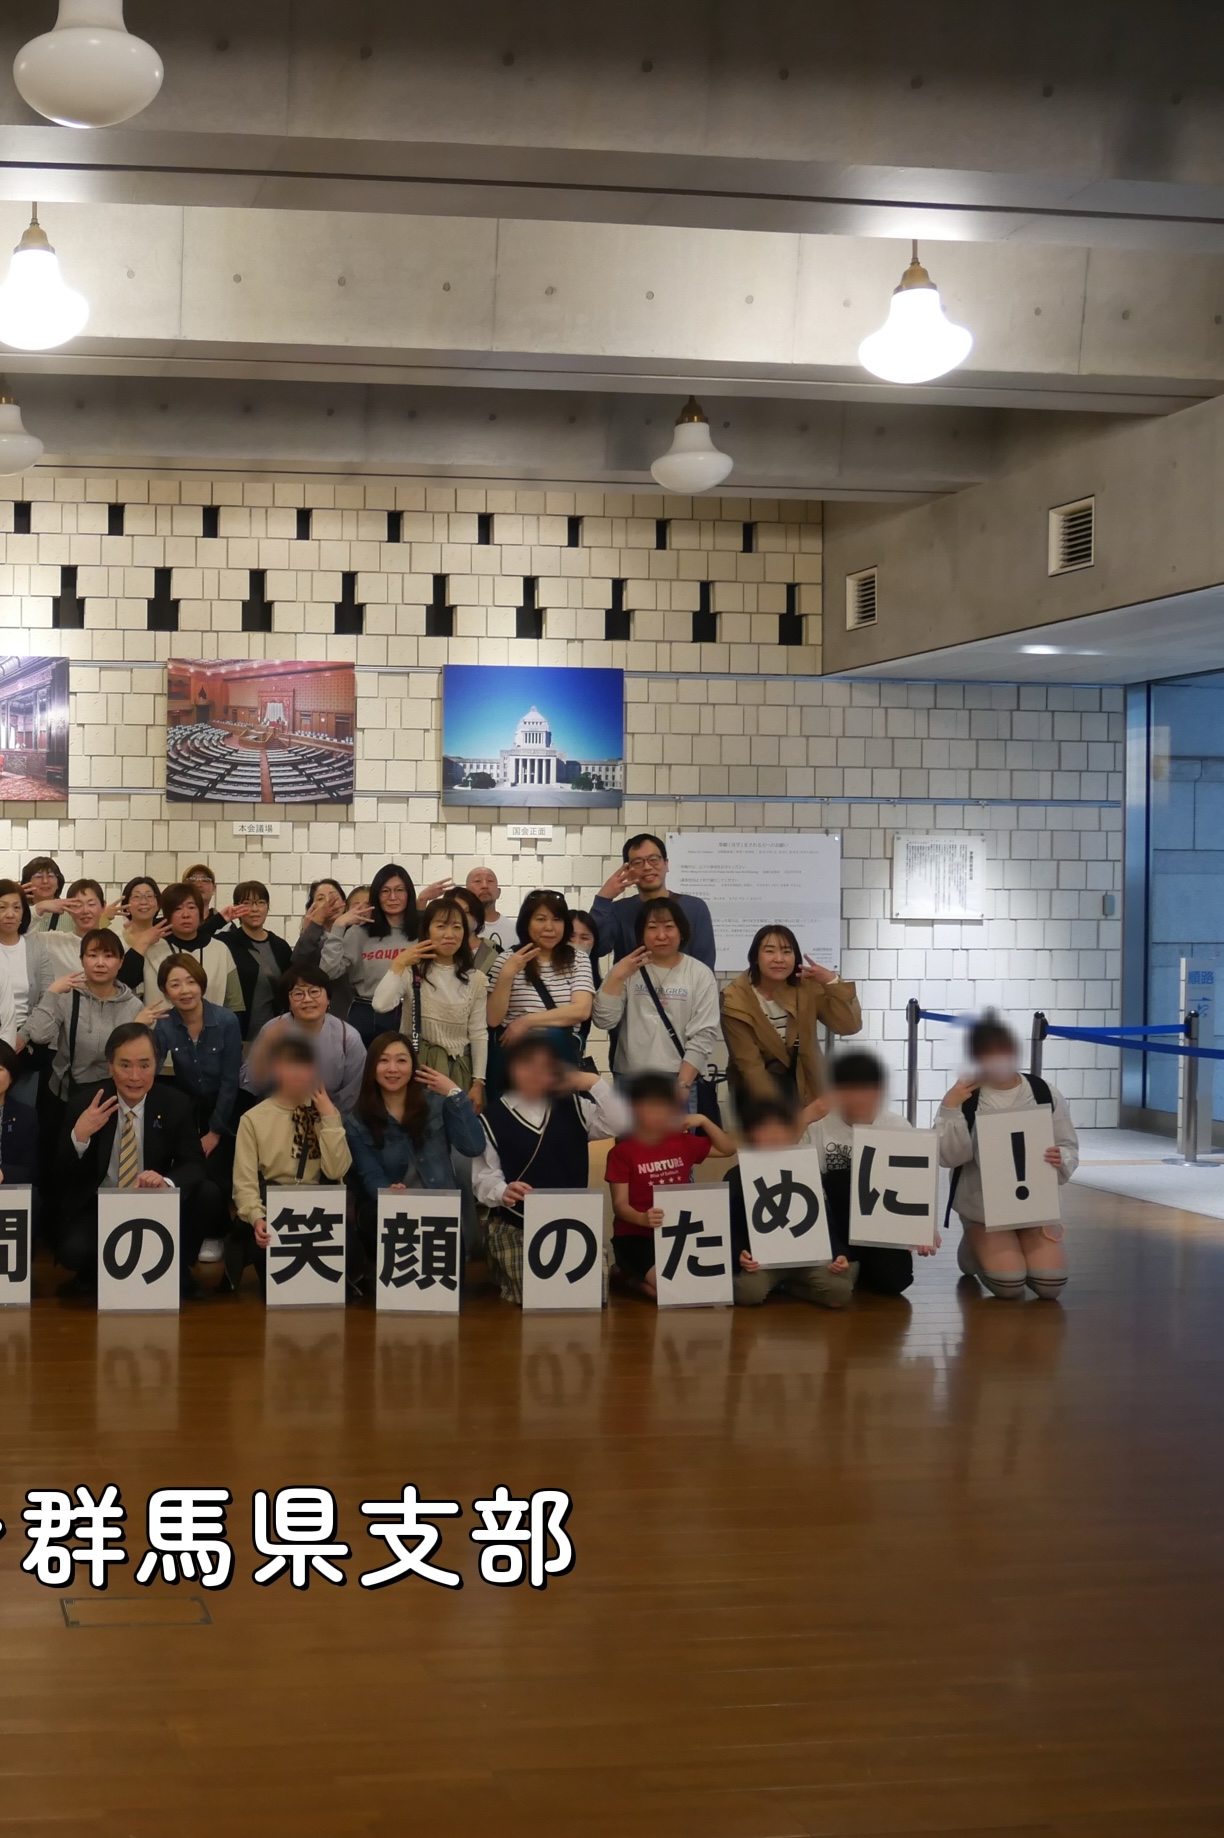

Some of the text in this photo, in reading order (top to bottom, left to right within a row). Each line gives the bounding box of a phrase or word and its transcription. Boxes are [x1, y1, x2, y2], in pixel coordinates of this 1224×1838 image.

[238, 824, 273, 833] 本会議場
[512, 826, 546, 836] 国会正面
[361, 948, 406, 960] DSQUA
[1188, 971, 1214, 985] 順路
[637, 1156, 684, 1174] NURTURE
[858, 1146, 930, 1216] に
[1011, 1132, 1030, 1200] !
[750, 1169, 819, 1239] め
[103, 1219, 174, 1284] の
[269, 1207, 345, 1284] 笑
[380, 1212, 459, 1291] 顔
[528, 1219, 597, 1283] の
[660, 1210, 726, 1280] た
